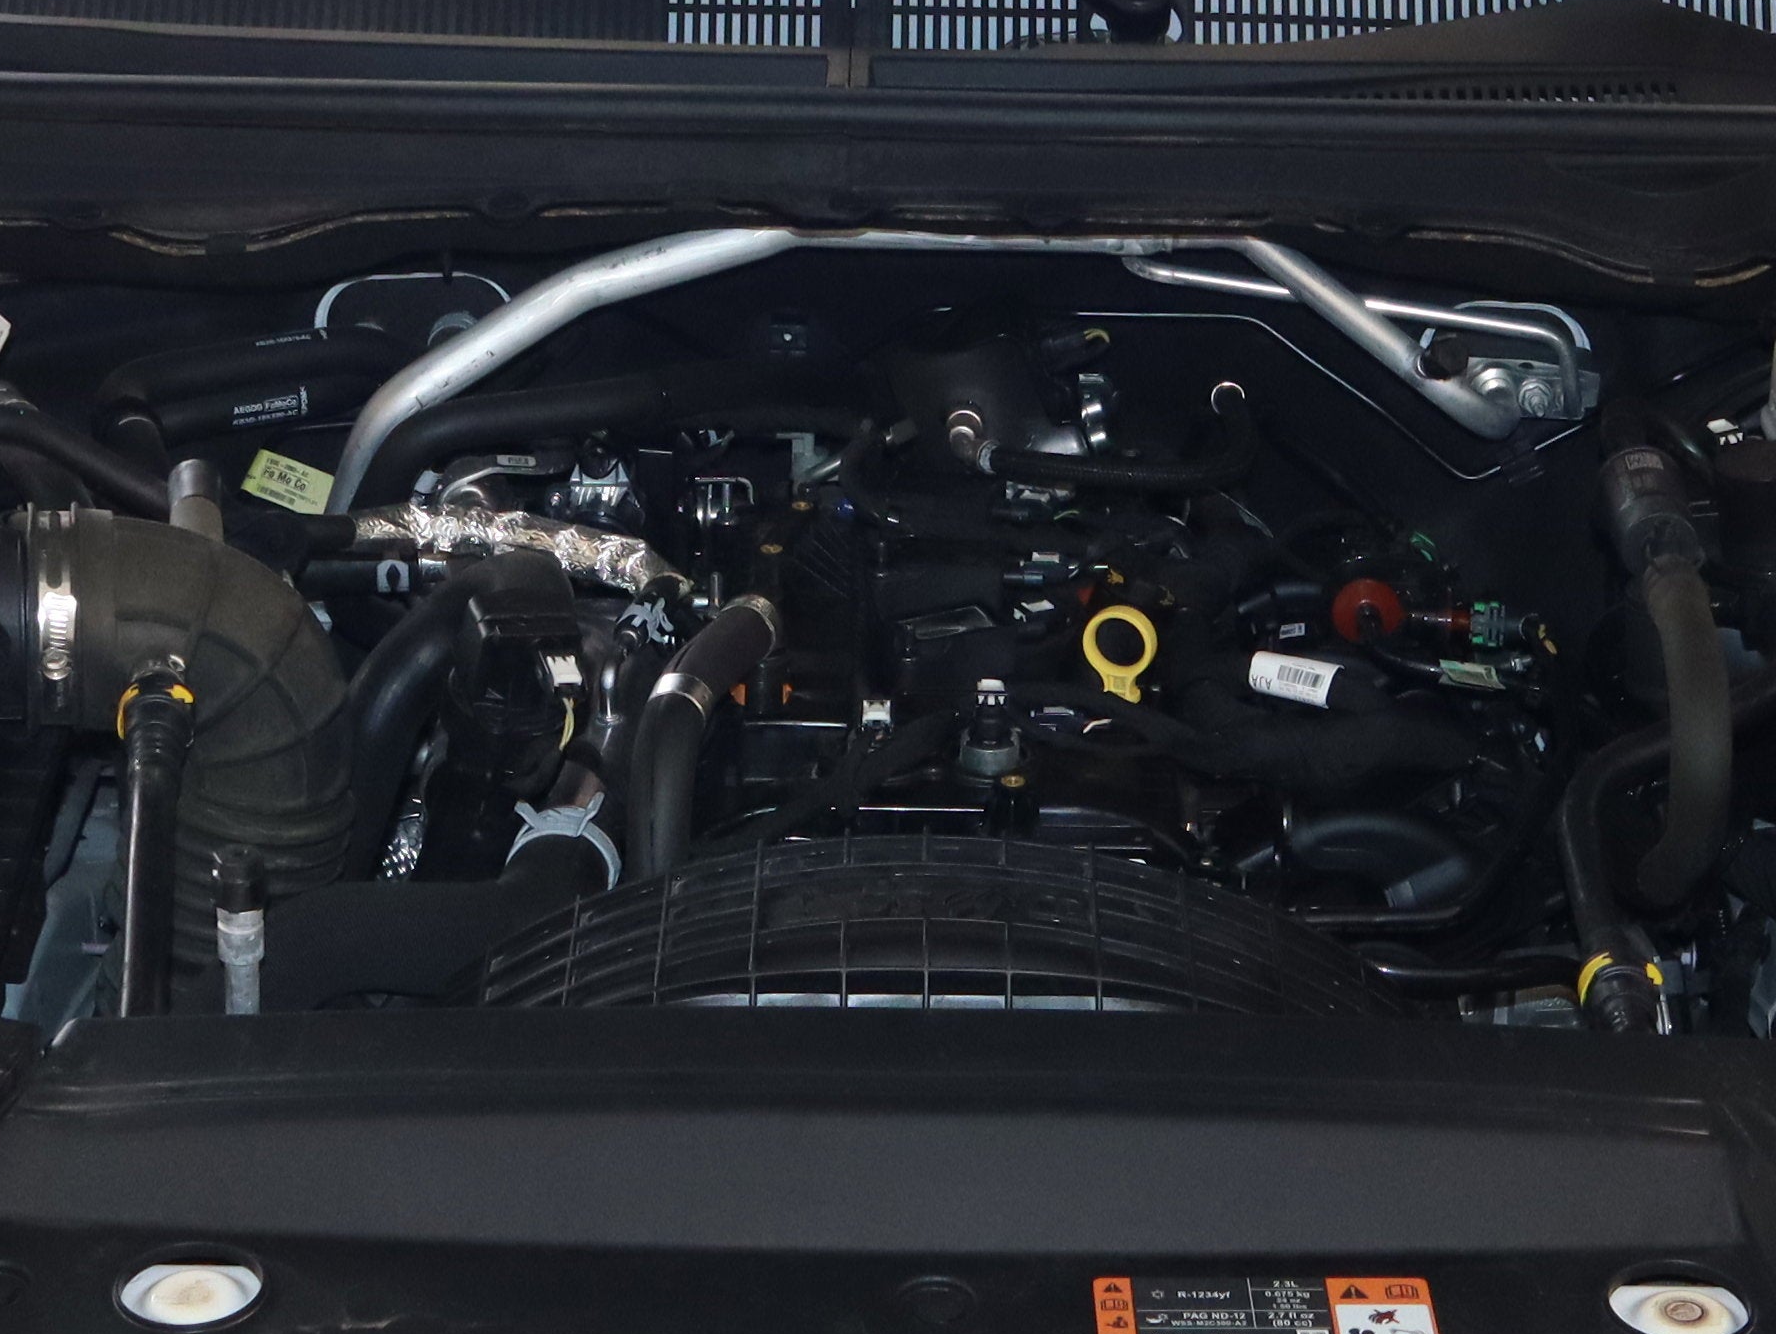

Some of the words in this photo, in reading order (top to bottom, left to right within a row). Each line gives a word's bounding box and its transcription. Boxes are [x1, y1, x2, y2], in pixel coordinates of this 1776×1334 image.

[1273, 1280, 1299, 1288] 2.3L
[1177, 1290, 1231, 1300] R-1234yf
[1296, 1290, 1311, 1299] kg
[1183, 1312, 1208, 1320] PAG
[1211, 1312, 1246, 1320] ND-12
[1268, 1312, 1285, 1320] 2.7
[1272, 1319, 1291, 1328] (80
[1294, 1319, 1313, 1328] cc)
